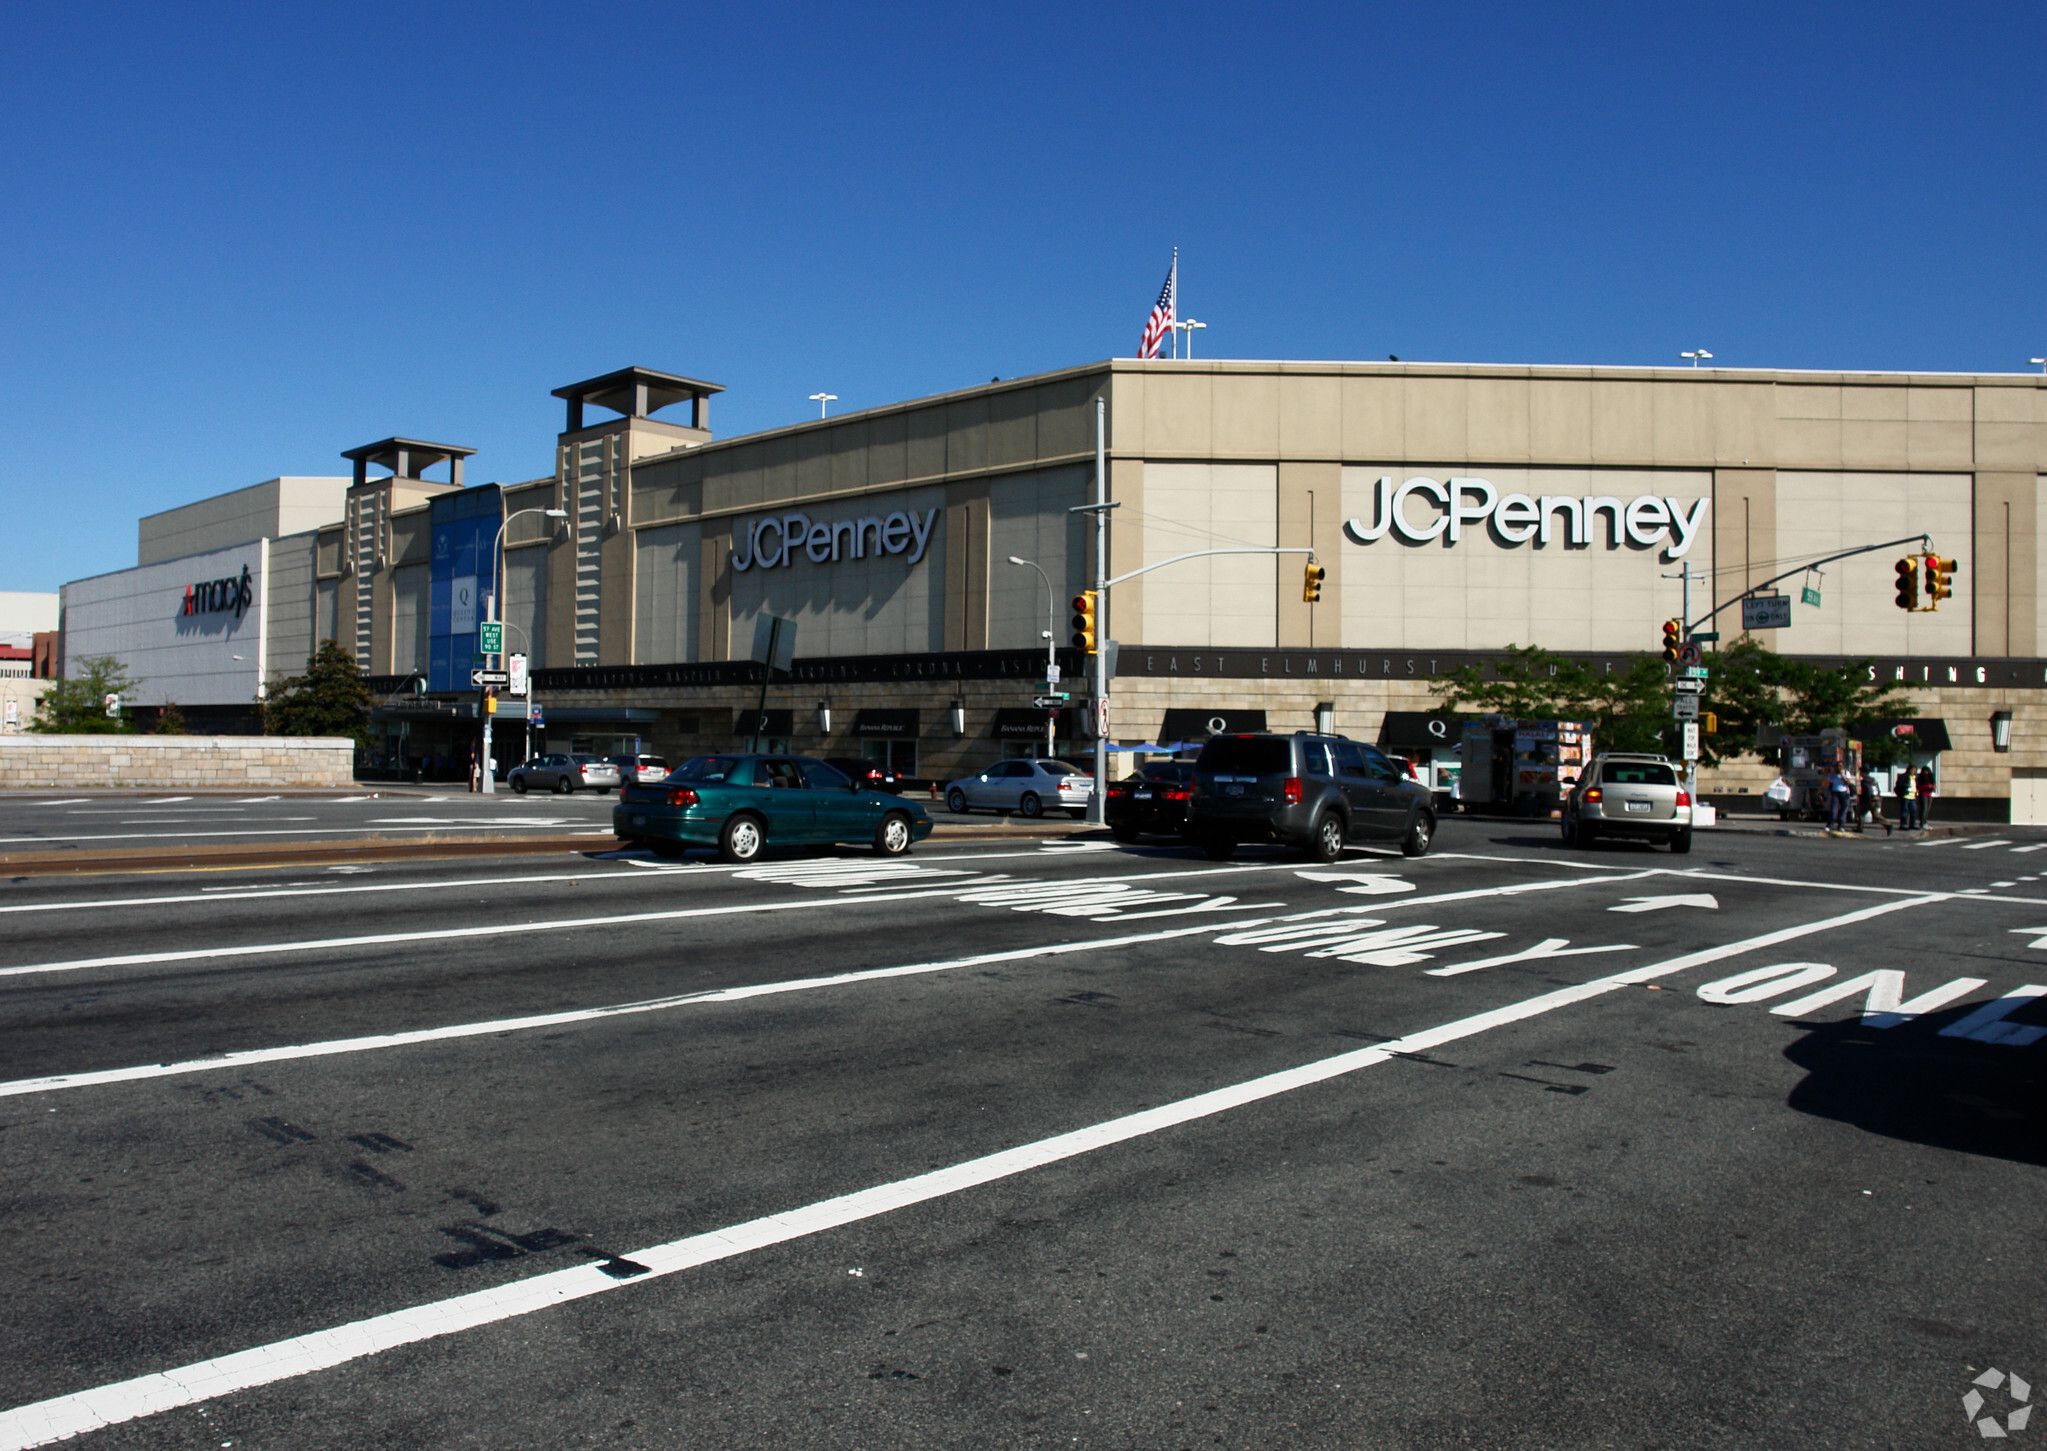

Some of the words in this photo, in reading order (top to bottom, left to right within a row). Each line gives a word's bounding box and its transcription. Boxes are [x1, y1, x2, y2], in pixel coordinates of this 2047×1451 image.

[1348, 475, 1711, 558] JCPenney
[732, 507, 941, 572] JCPenney
[193, 564, 252, 618] macy's
[459, 588, 469, 606] Q
[1767, 600, 1789, 608] TURN
[1770, 613, 1787, 621] ONLY
[892, 661, 961, 676] CORONA
[1000, 657, 1085, 675] ASTOI
[1147, 656, 1224, 672] EAST
[1262, 658, 1437, 674] ELMHURST
[1000, 724, 1026, 732] BANANA
[1026, 724, 1045, 732] REPU
[1208, 716, 1227, 735] Q
[1427, 719, 1447, 739] Q
[954, 883, 1287, 922] ONLY
[1213, 918, 1640, 976] ONLY
